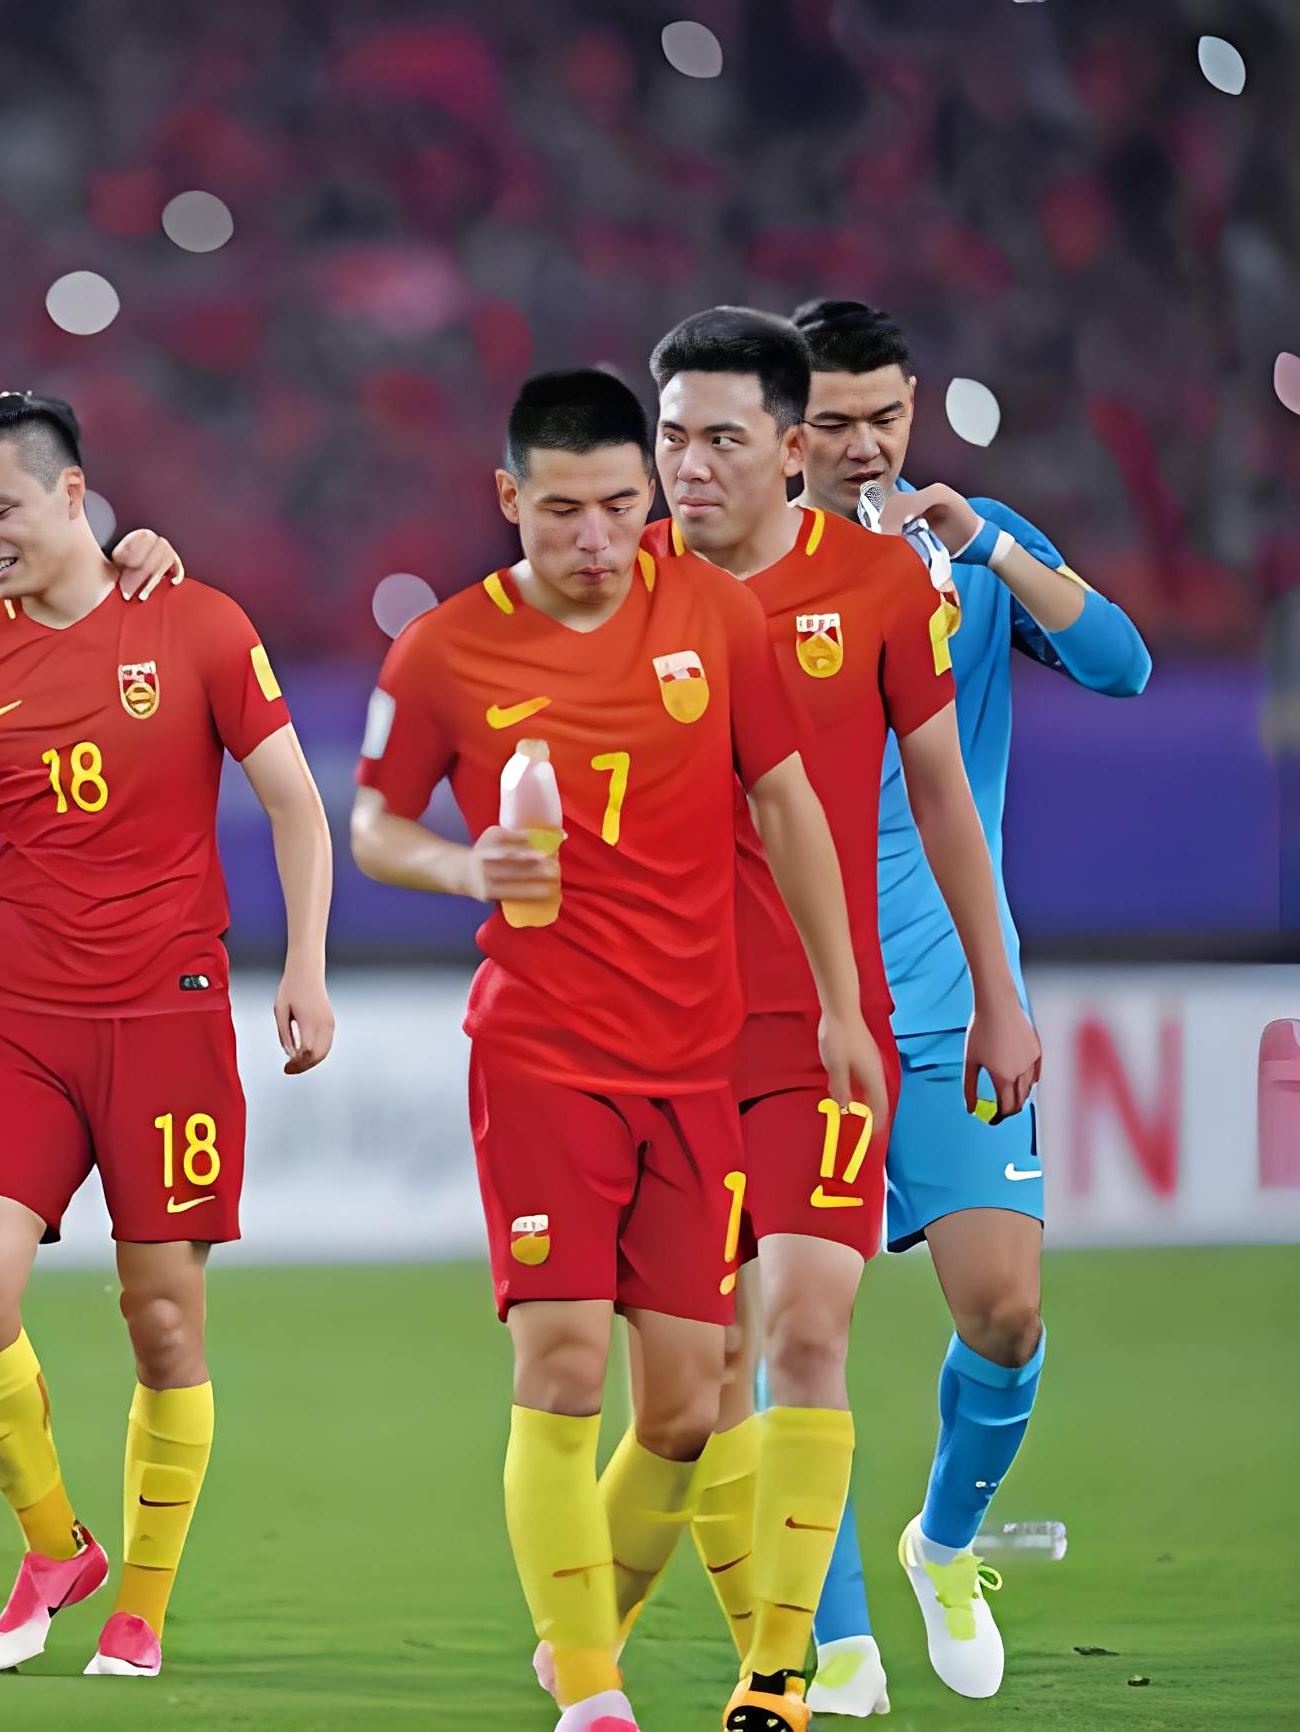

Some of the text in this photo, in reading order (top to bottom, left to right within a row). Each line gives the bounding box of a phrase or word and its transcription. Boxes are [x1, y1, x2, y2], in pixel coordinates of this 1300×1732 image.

[41, 741, 109, 814] 18
[590, 750, 631, 846] 7
[153, 1112, 221, 1188] 18
[816, 1097, 874, 1185] 17
